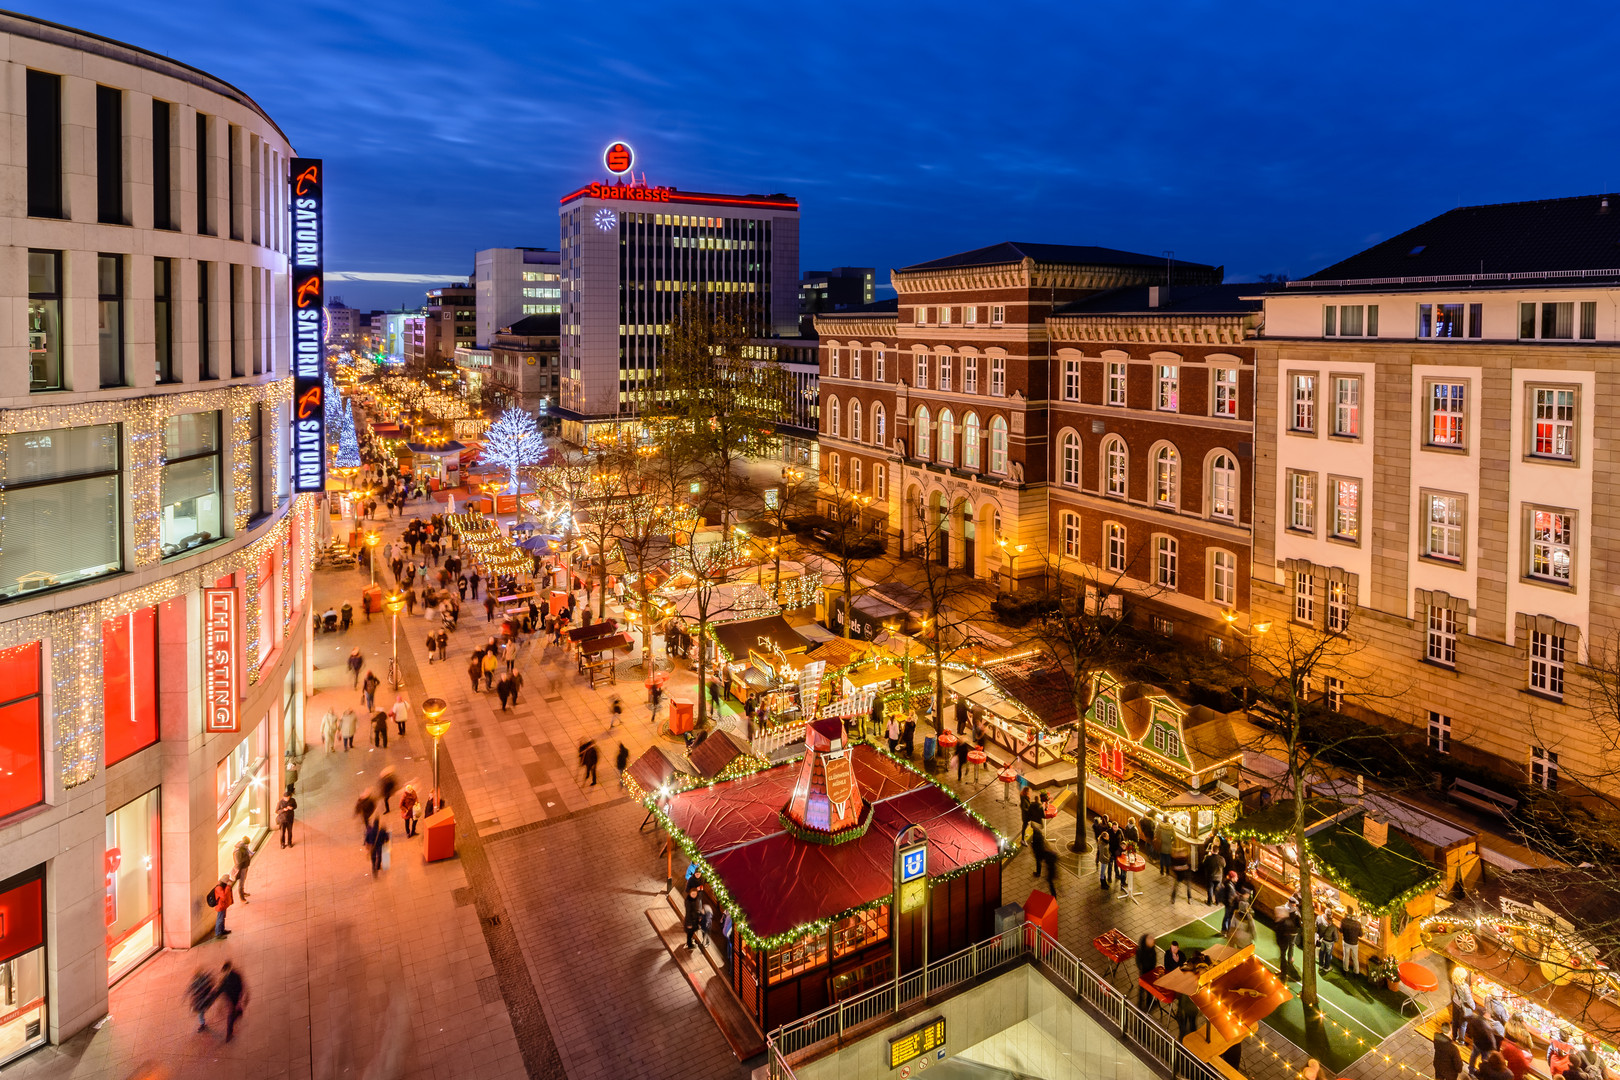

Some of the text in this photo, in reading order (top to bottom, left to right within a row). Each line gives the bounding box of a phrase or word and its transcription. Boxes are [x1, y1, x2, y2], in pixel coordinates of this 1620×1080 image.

[590, 181, 669, 202] Sparkasse
[296, 198, 318, 266] SATURN
[298, 309, 319, 378] SATURN
[298, 420, 320, 488] SATURN
[213, 597, 230, 723] THE STING
[907, 853, 921, 875] U
